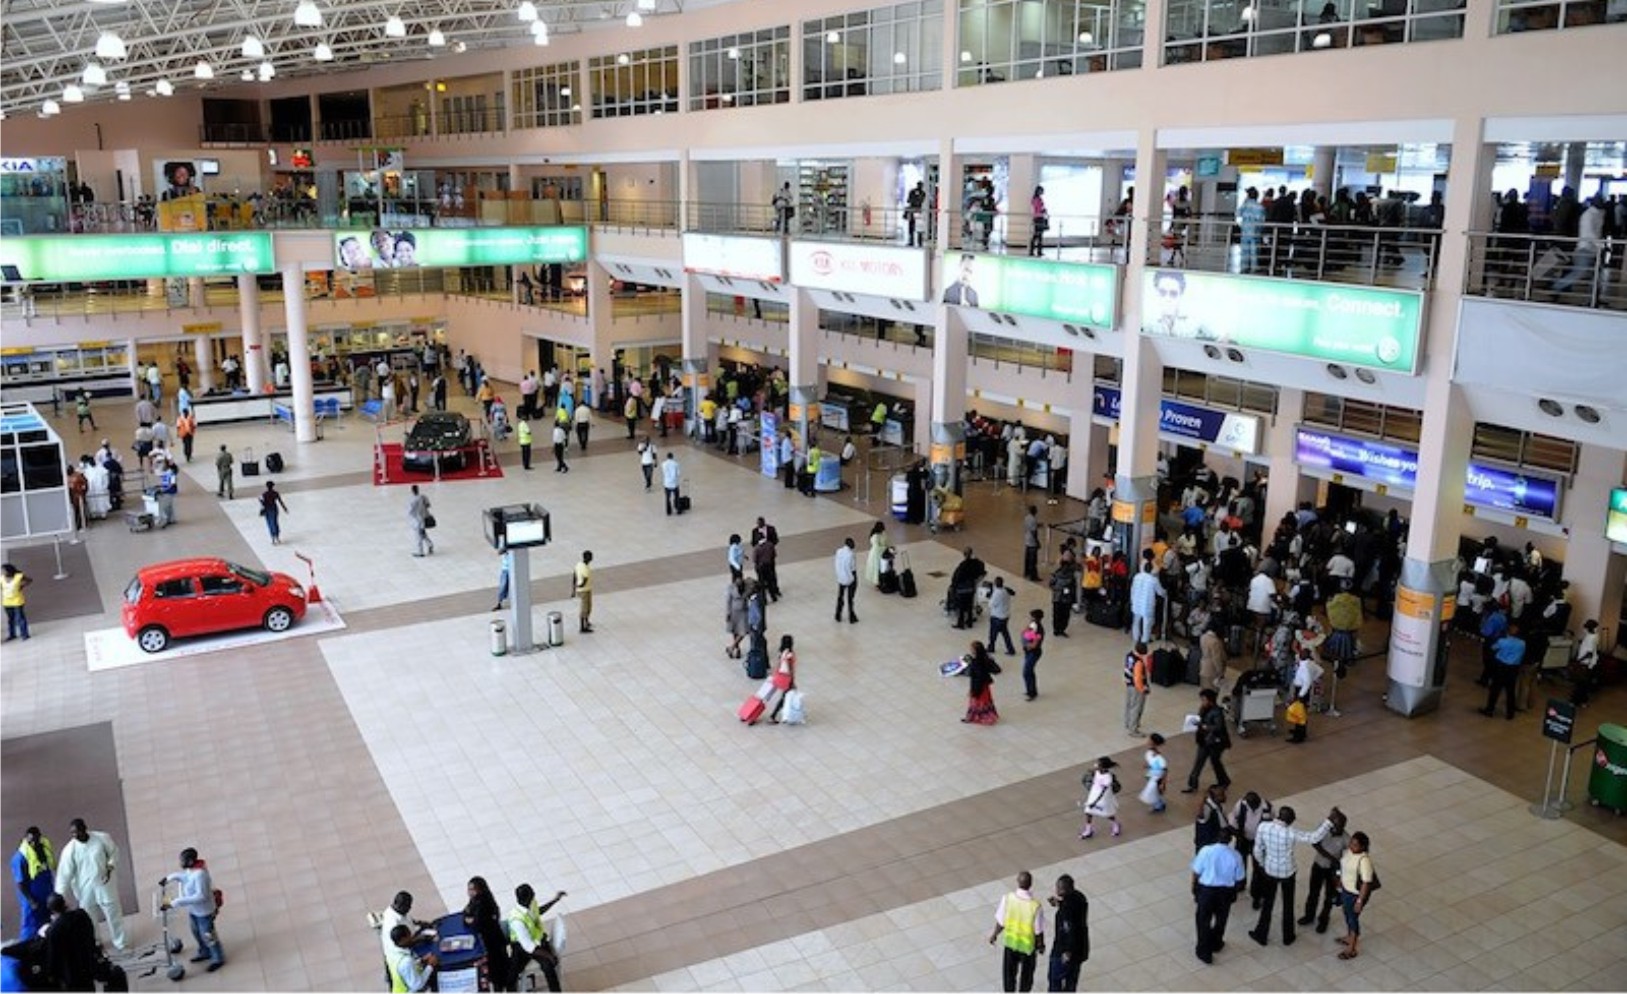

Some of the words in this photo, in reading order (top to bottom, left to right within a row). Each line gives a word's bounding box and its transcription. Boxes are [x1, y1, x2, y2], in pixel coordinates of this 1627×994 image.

[1327, 294, 1405, 318] Connect.
[1165, 409, 1202, 429] Proven
[1357, 448, 1400, 468] Wishes
[1400, 460, 1417, 472] yo
[1467, 472, 1495, 490] trip.
